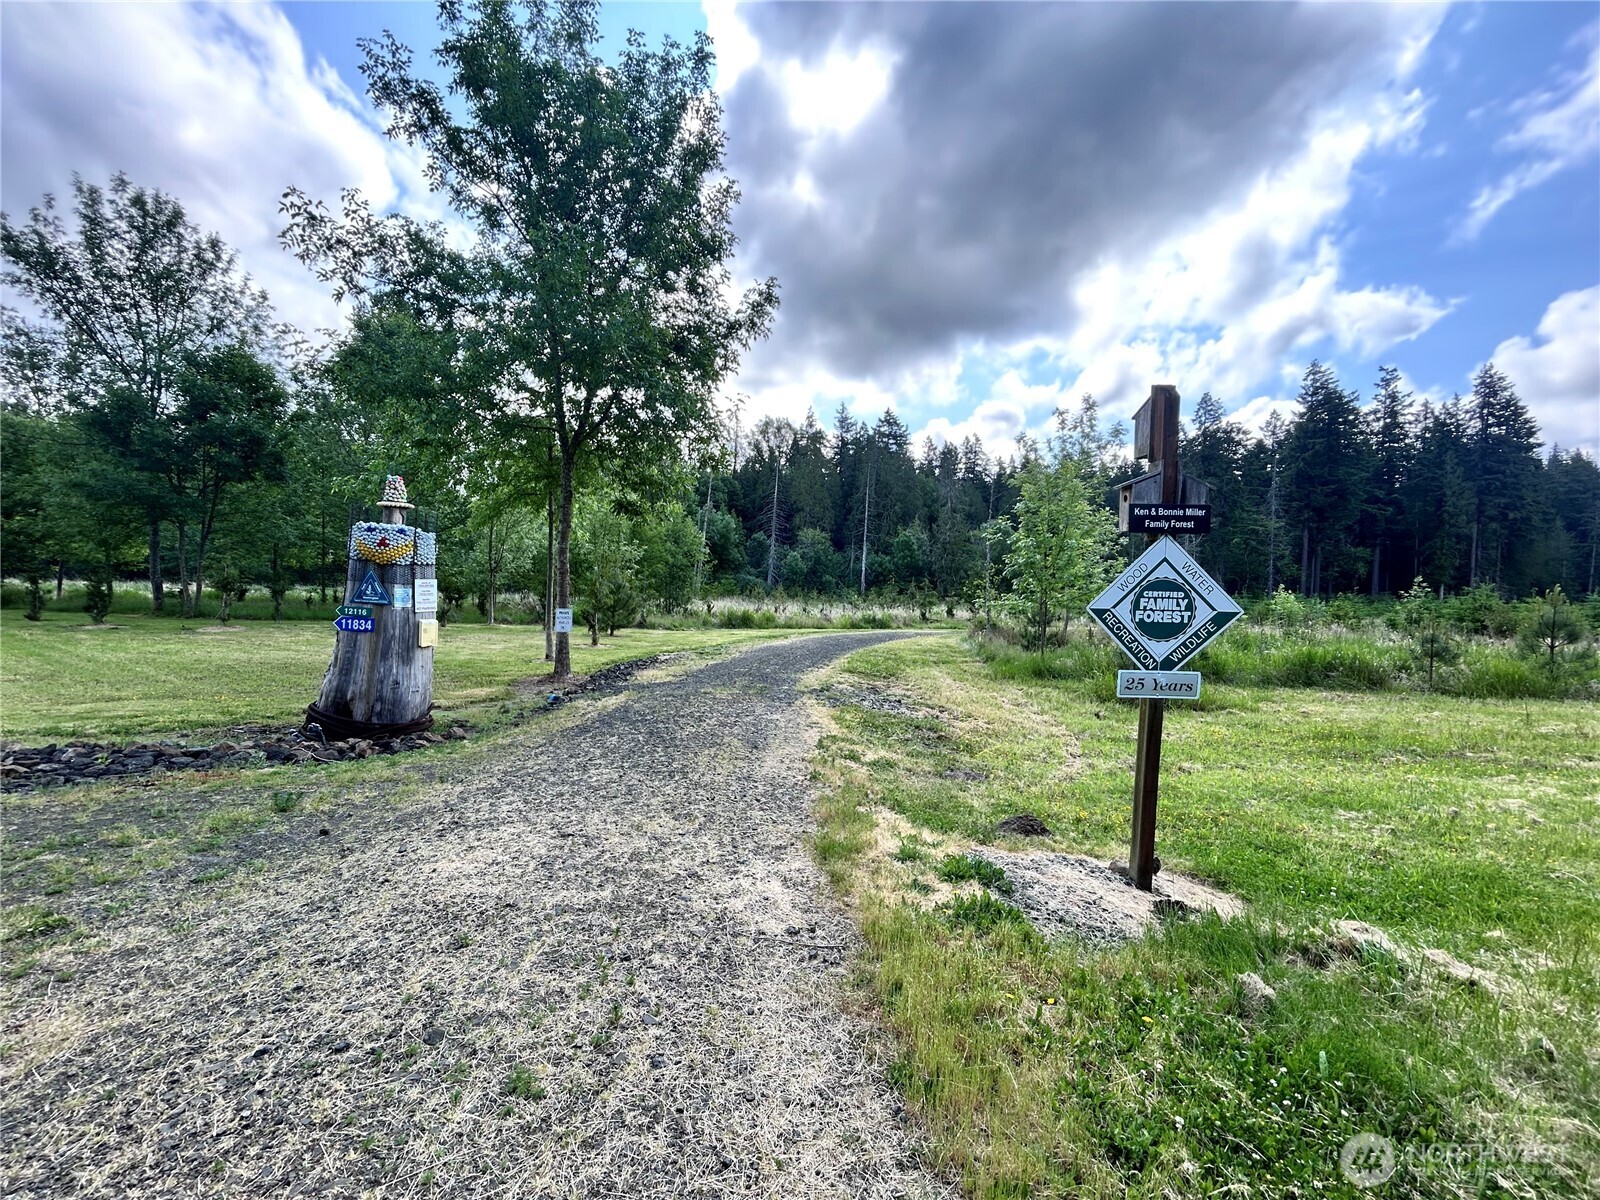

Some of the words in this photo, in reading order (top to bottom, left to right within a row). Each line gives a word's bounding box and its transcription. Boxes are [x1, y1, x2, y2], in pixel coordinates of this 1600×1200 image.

[1134, 508, 1149, 516] Ken
[1150, 508, 1157, 516] &
[1158, 508, 1184, 516] Bonnie
[1185, 508, 1206, 516] Miller
[1145, 520, 1170, 529] Family
[1170, 520, 1195, 528] Forest
[1117, 563, 1148, 592] WOOD
[1181, 562, 1214, 595] WATER
[1139, 597, 1189, 611] FAMILY
[1135, 610, 1191, 624] FOREST
[341, 618, 372, 631] 11834
[1102, 611, 1157, 670] RECREATION
[1169, 620, 1218, 663] WILDLIFE
[1124, 677, 1145, 691] 25
[1150, 677, 1194, 692] Years
